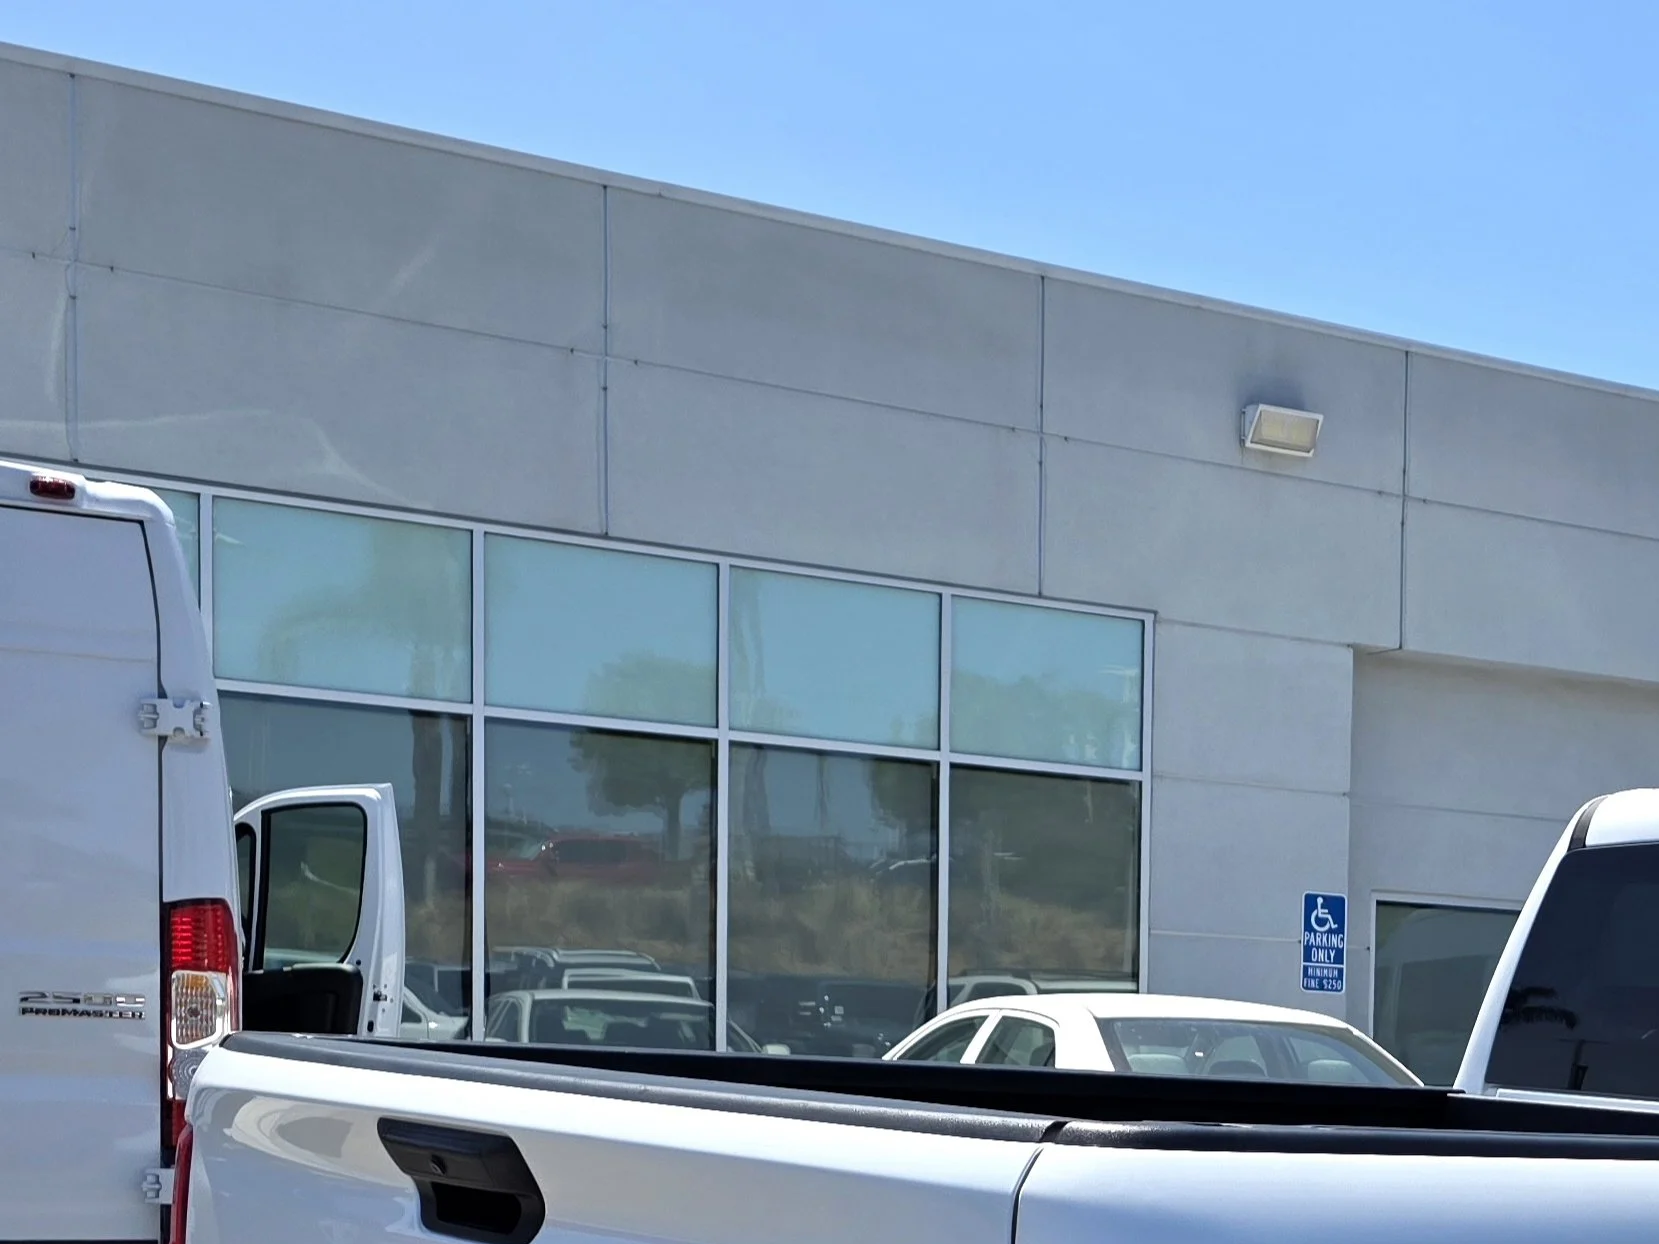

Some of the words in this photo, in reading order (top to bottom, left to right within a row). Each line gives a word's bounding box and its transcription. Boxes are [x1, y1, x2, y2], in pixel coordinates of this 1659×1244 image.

[1304, 931, 1344, 948] PARKING
[1311, 948, 1336, 963] ONLY
[1308, 967, 1338, 977] MINIMUM
[1303, 978, 1319, 988] FINE
[1323, 979, 1342, 989] $250
[19, 991, 146, 1007] 2500
[19, 1007, 146, 1020] PROMASTER
